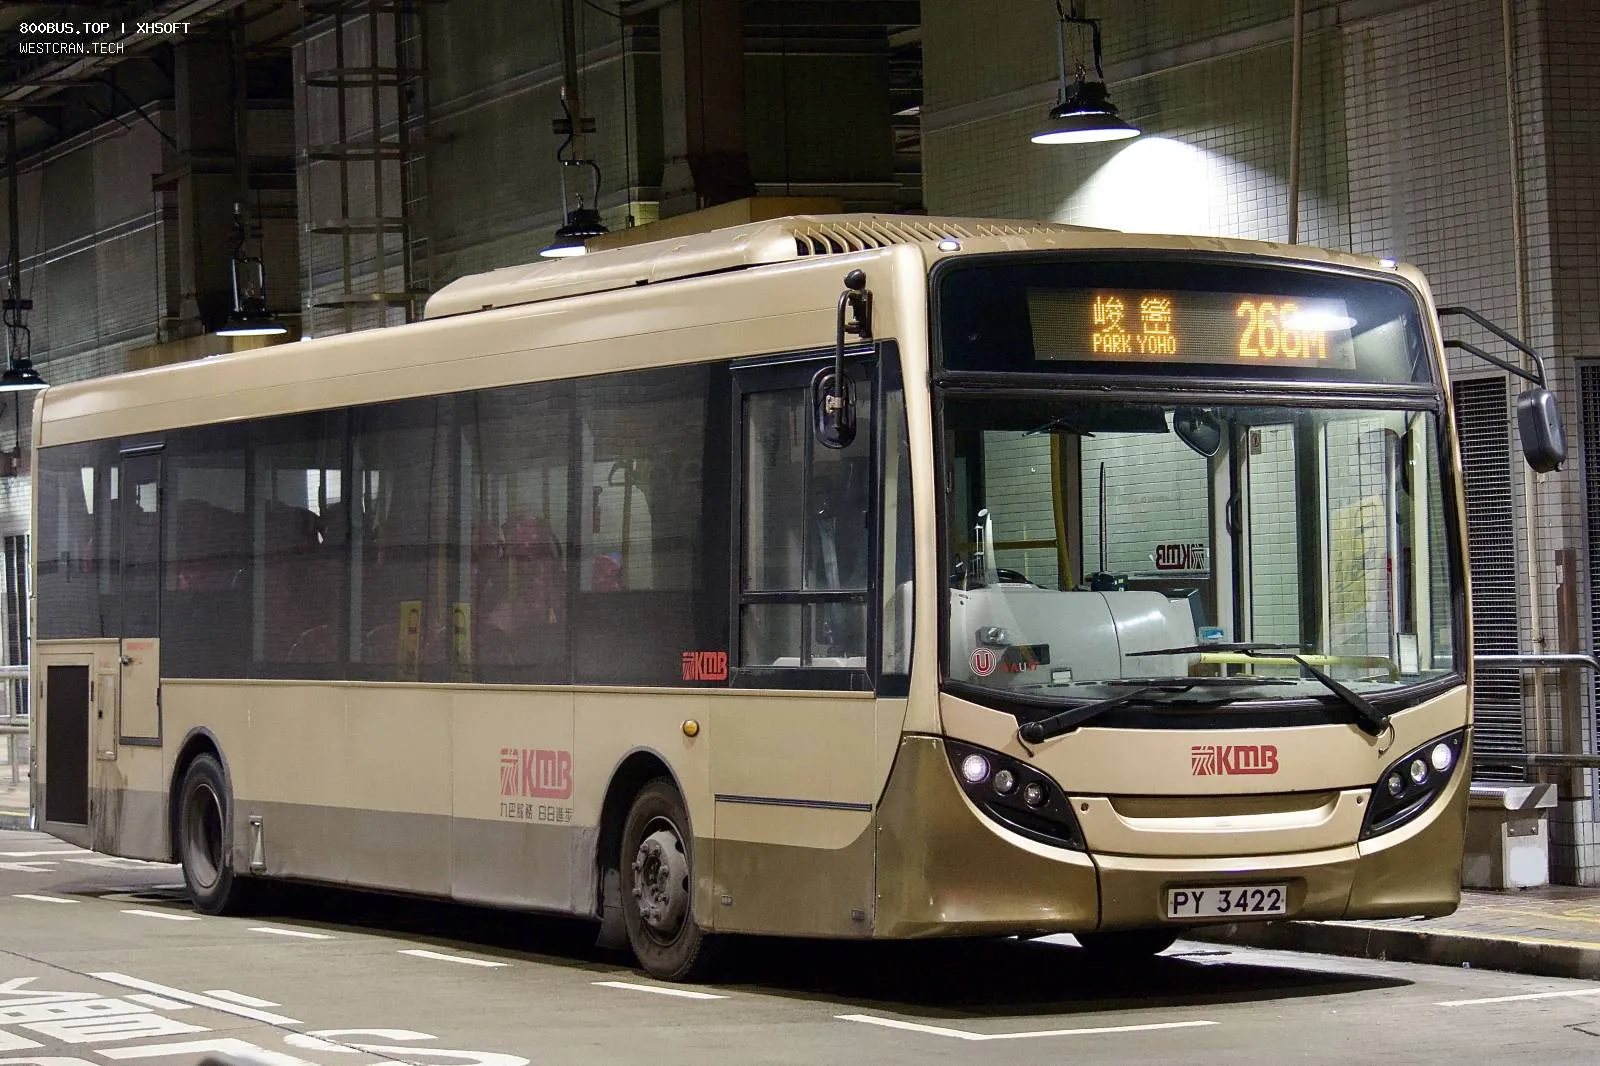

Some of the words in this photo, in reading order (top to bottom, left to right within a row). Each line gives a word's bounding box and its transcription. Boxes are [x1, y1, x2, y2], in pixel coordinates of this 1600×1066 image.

[1093, 333, 1131, 353] PARK
[1136, 335, 1176, 354] YOHO
[695, 651, 728, 681] KMB
[975, 653, 991, 673] U
[521, 748, 573, 800] KMB
[1216, 744, 1280, 776] KMB
[1173, 890, 1205, 915] PY
[1217, 888, 1281, 913] 3422
